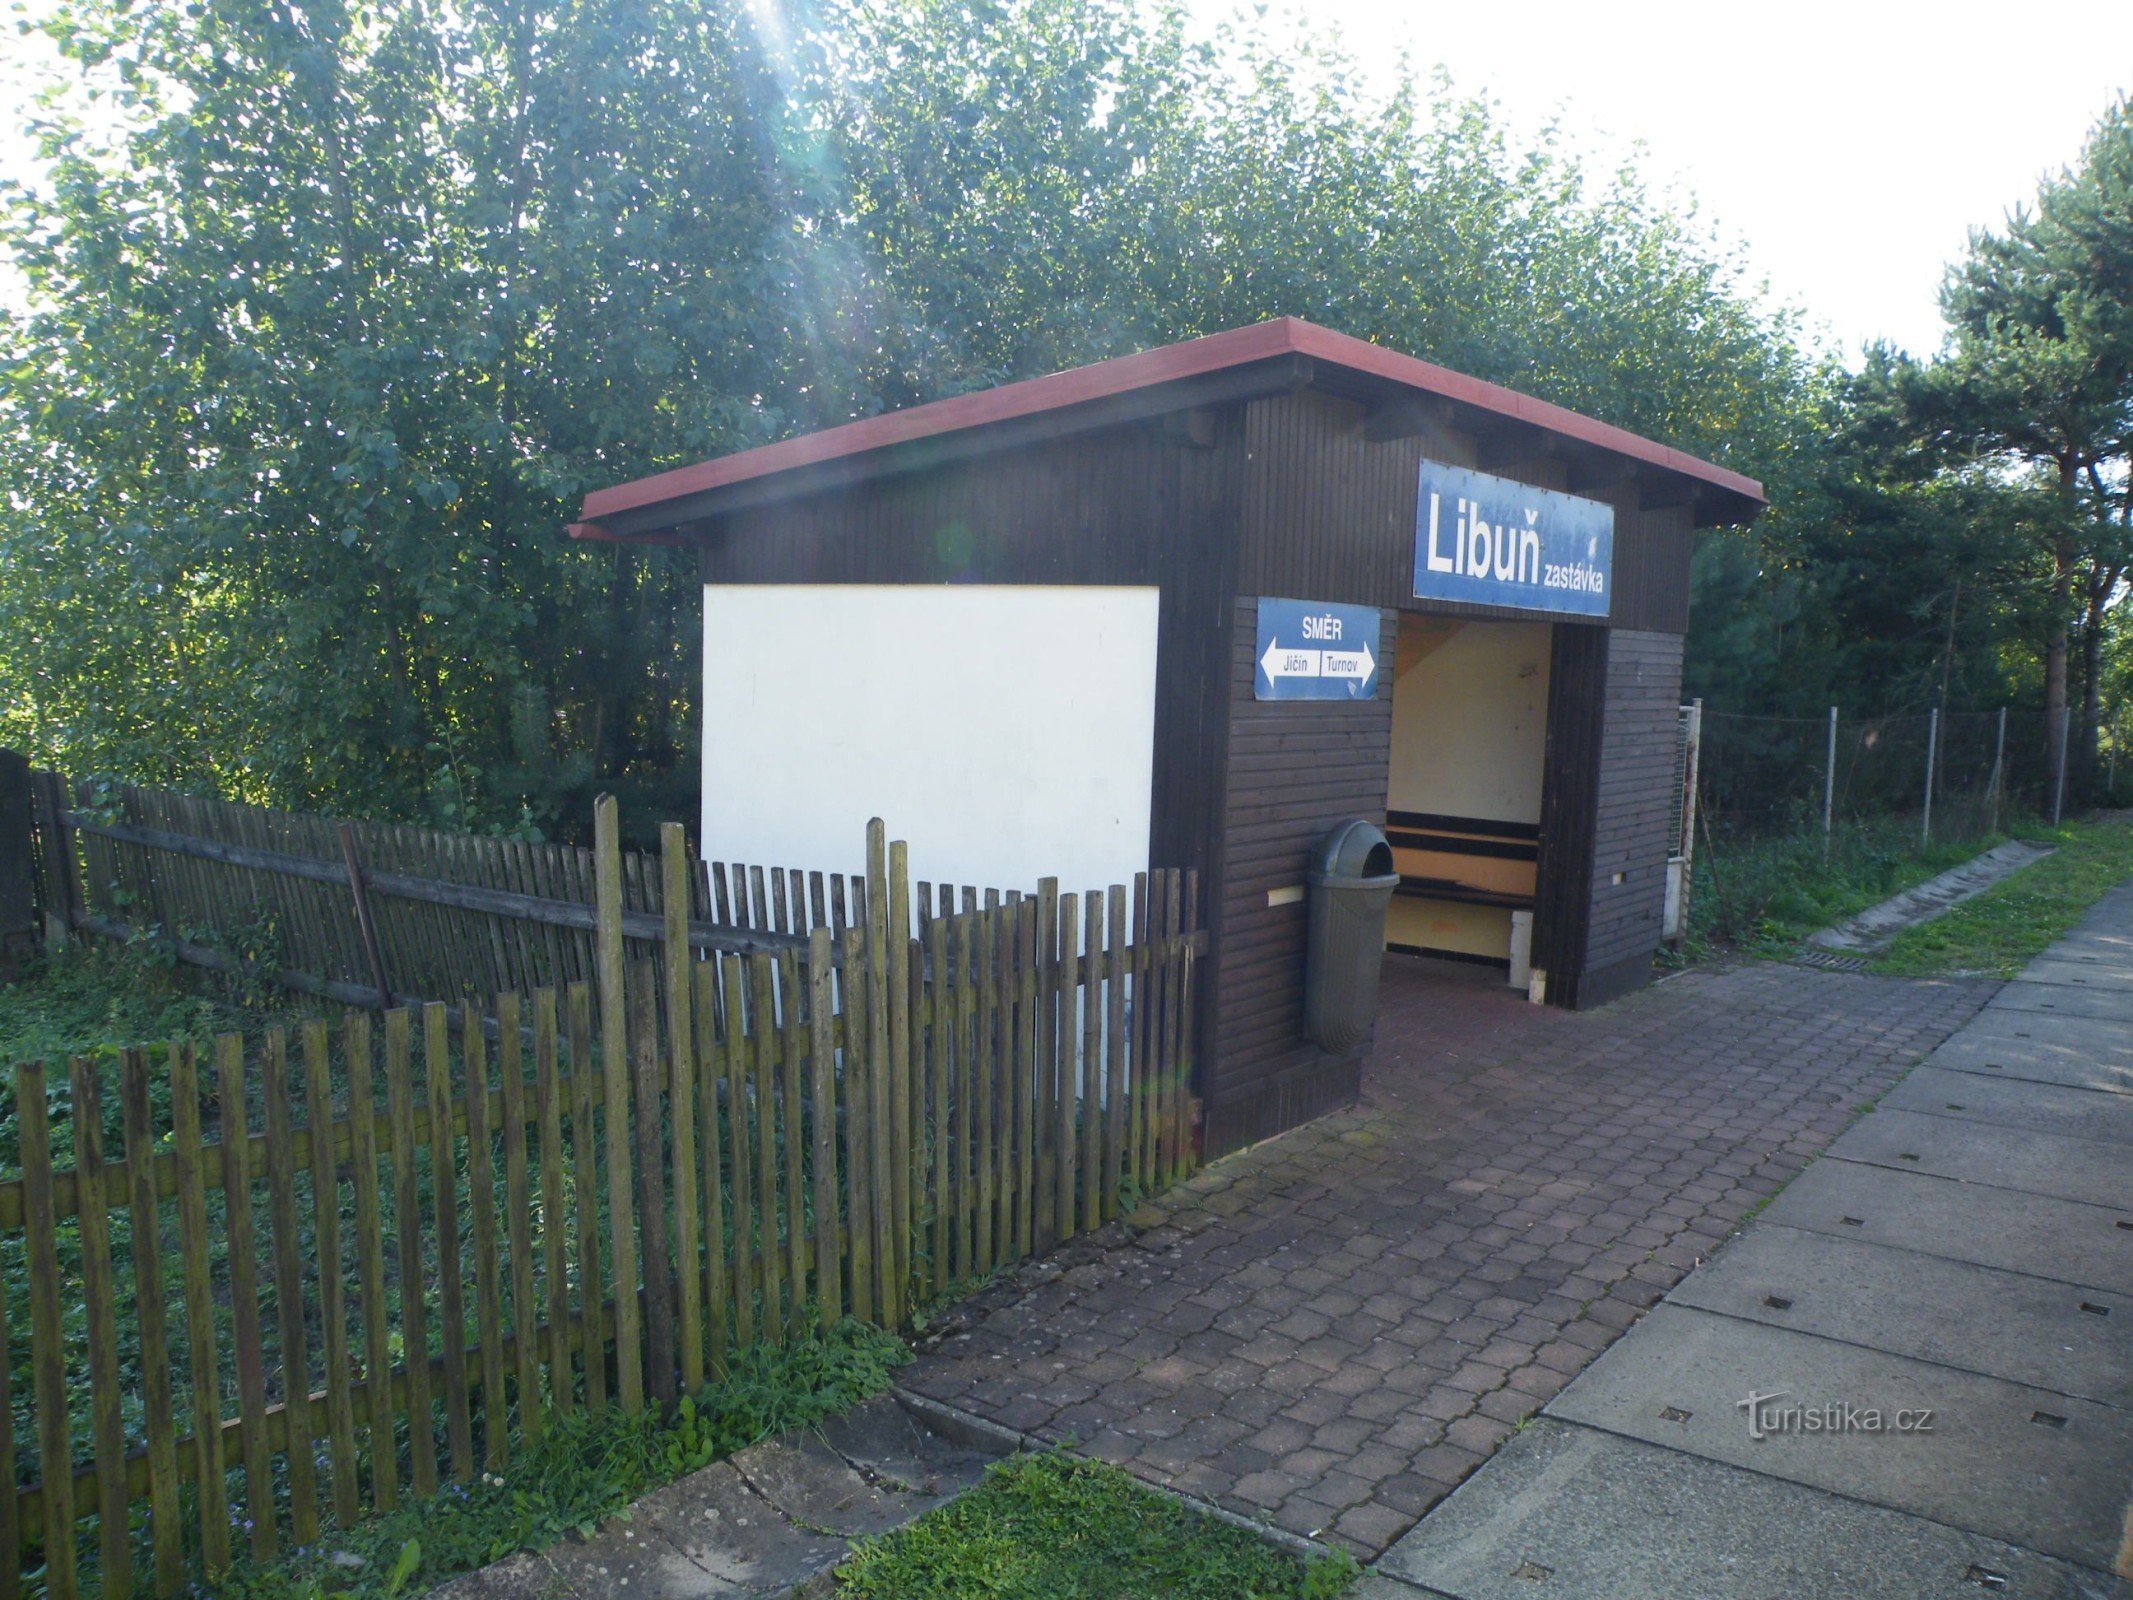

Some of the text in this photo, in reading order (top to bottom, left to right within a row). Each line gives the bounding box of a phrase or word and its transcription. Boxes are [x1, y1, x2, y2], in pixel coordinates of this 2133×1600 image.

[1427, 493, 1604, 593] Libuň zastávka
[1302, 613, 1342, 641] SMĚR
[1283, 655, 1359, 673] Jičín Turnov
